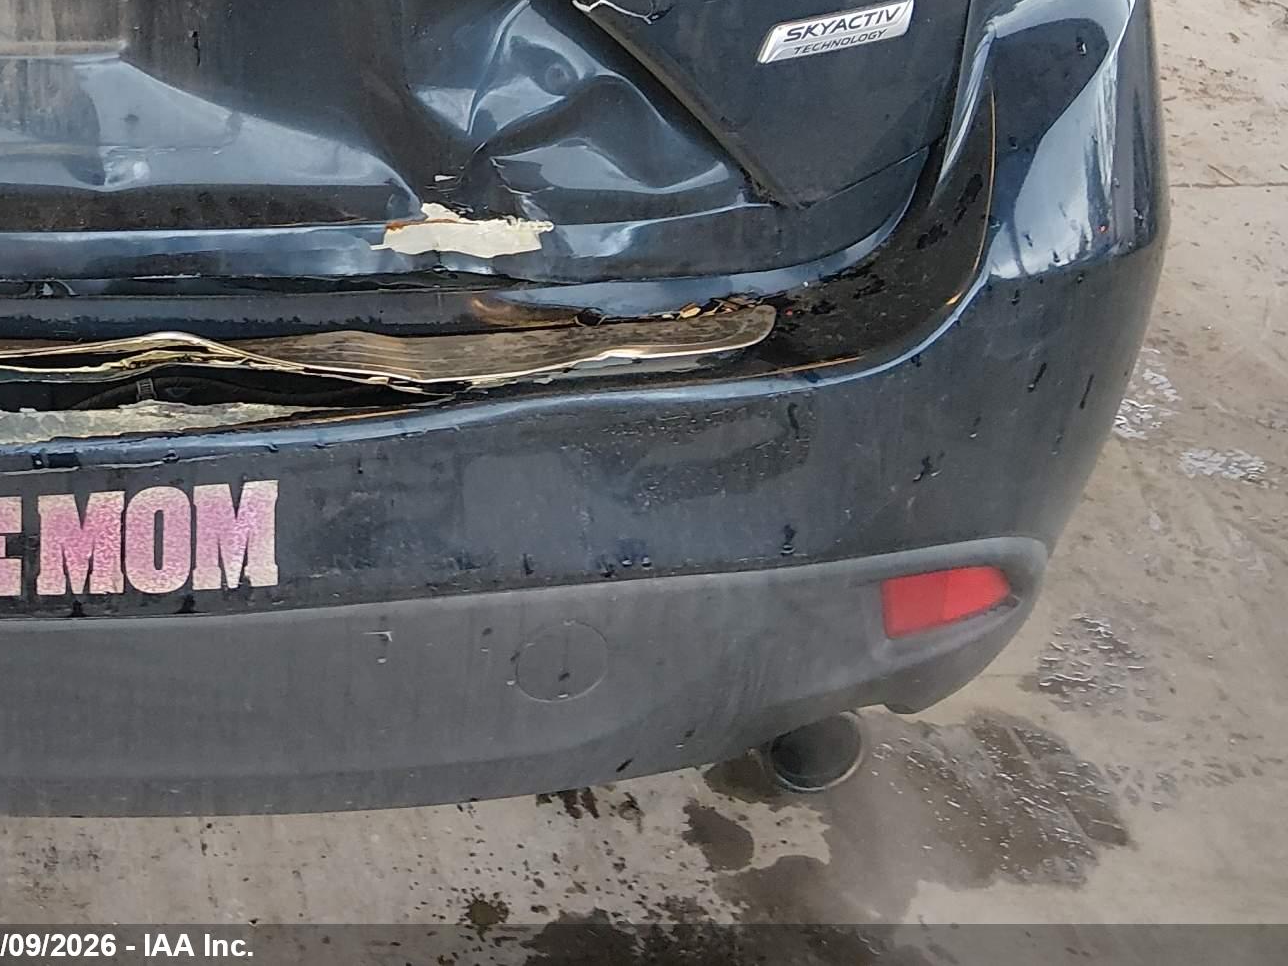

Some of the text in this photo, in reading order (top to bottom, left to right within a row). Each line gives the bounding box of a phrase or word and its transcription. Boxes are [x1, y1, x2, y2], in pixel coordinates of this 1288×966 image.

[784, 6, 901, 43] SKYACTIV
[793, 28, 888, 55] TECHNOLOGY
[36, 479, 279, 595] MOM
